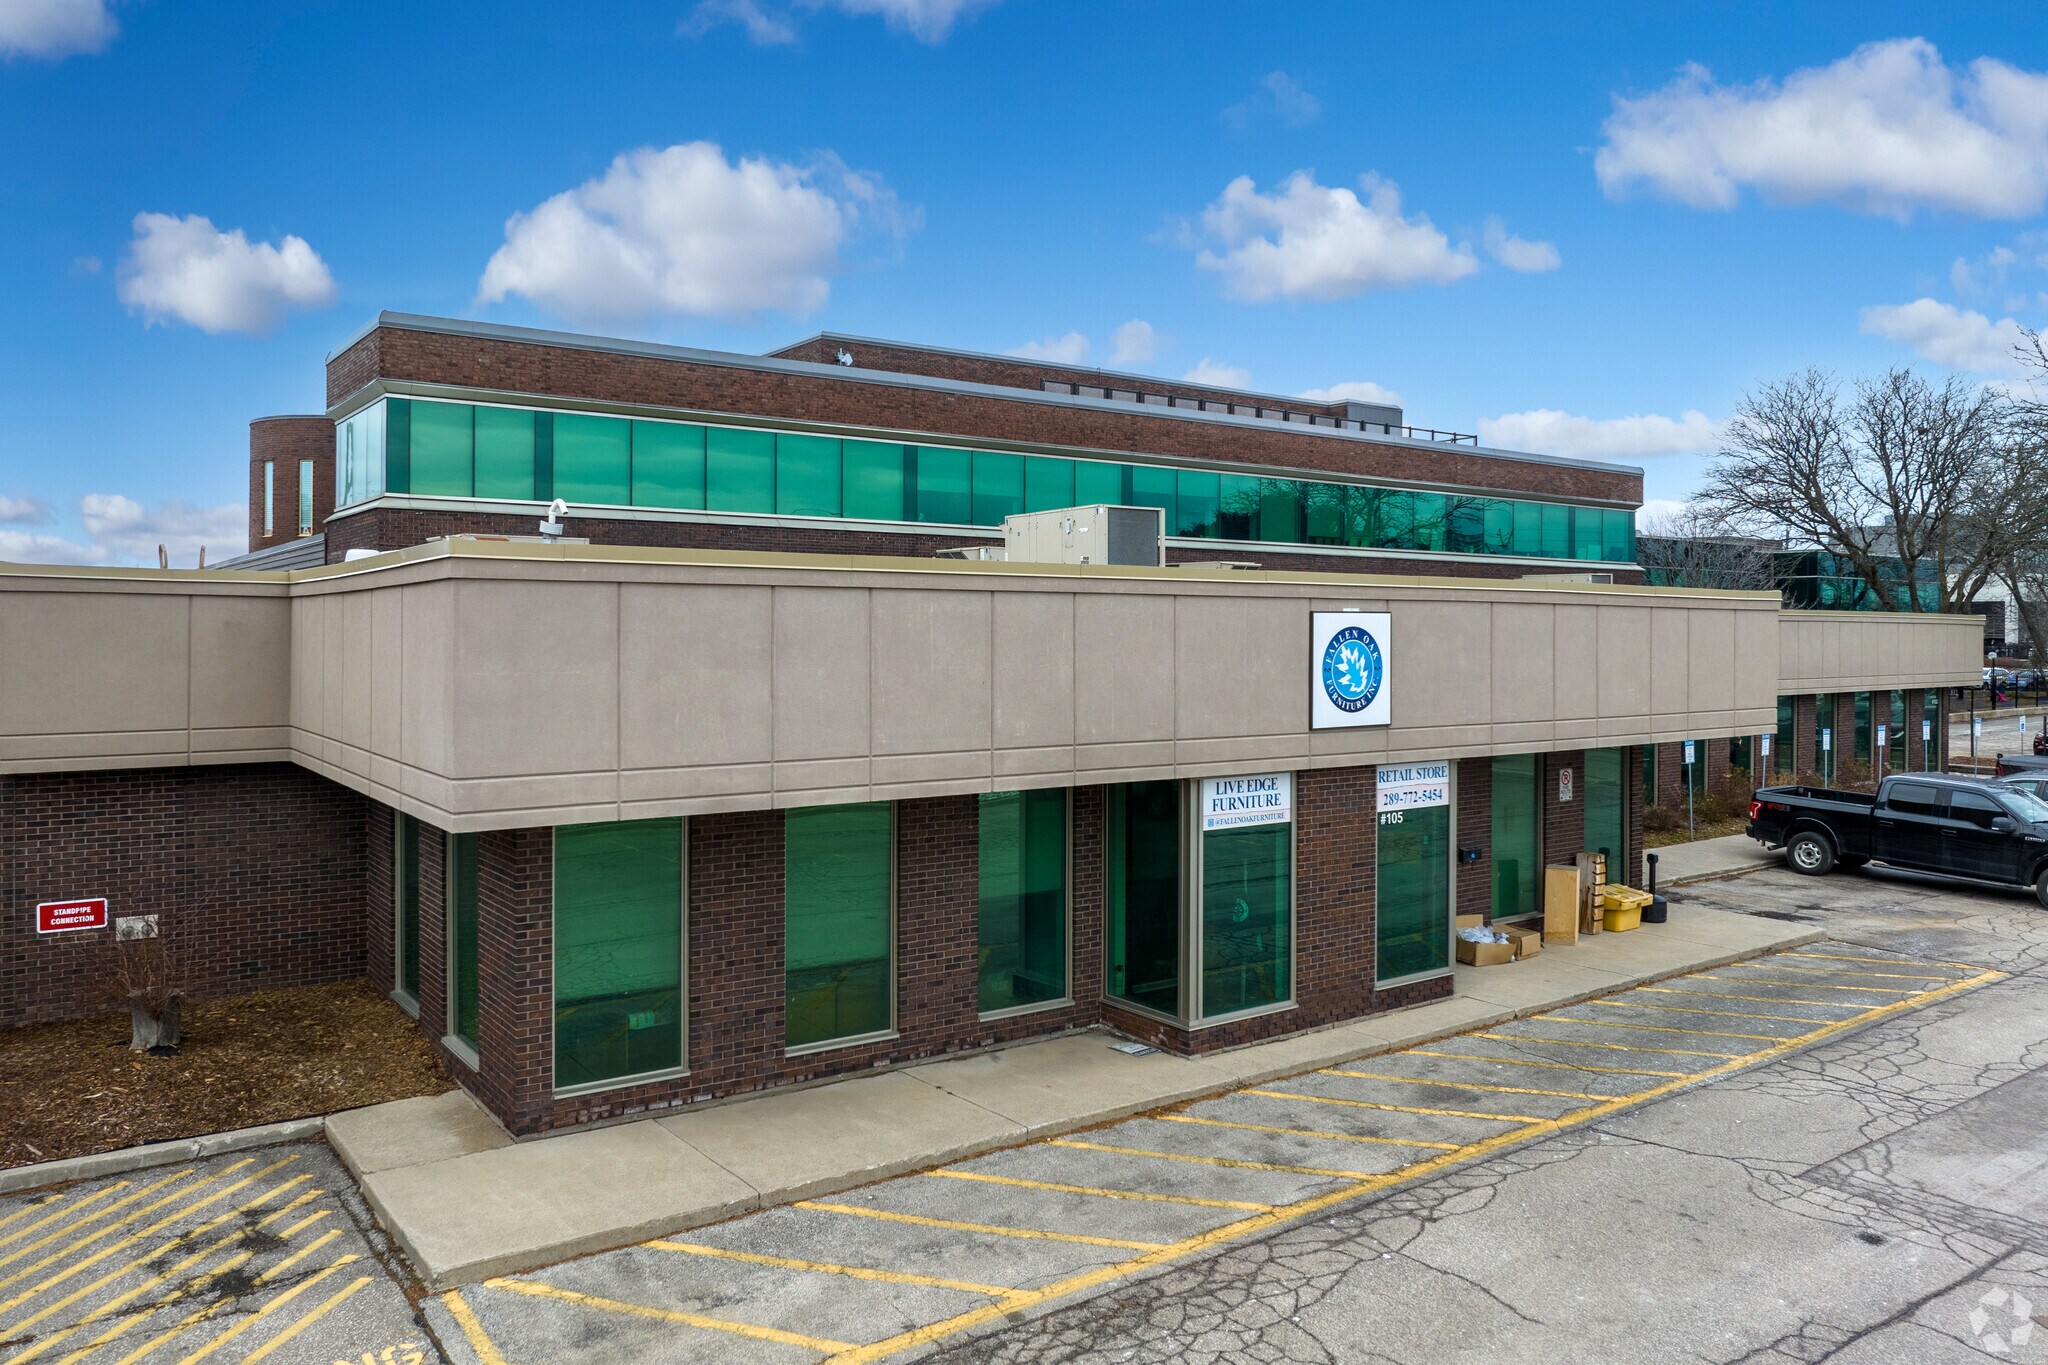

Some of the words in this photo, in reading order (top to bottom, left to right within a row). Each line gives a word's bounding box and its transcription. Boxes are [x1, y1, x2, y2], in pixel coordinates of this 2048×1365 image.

[1326, 629, 1359, 664] FALLEN
[1363, 635, 1380, 661] OAK
[1326, 680, 1367, 711] FURNITURE
[1378, 769, 1415, 784] RETAIL
[1416, 765, 1448, 780] STORE
[1215, 781, 1245, 796] LIVE
[1247, 777, 1279, 793] EDGE
[1212, 793, 1282, 812] FURNITURE
[1383, 788, 1443, 806] 289-772-5454
[1215, 812, 1286, 827] @FALLENOAKFURNITURE
[1380, 811, 1404, 825] #105
[50, 915, 95, 925] CONNECTION
[53, 906, 92, 916] STANDPIPE
